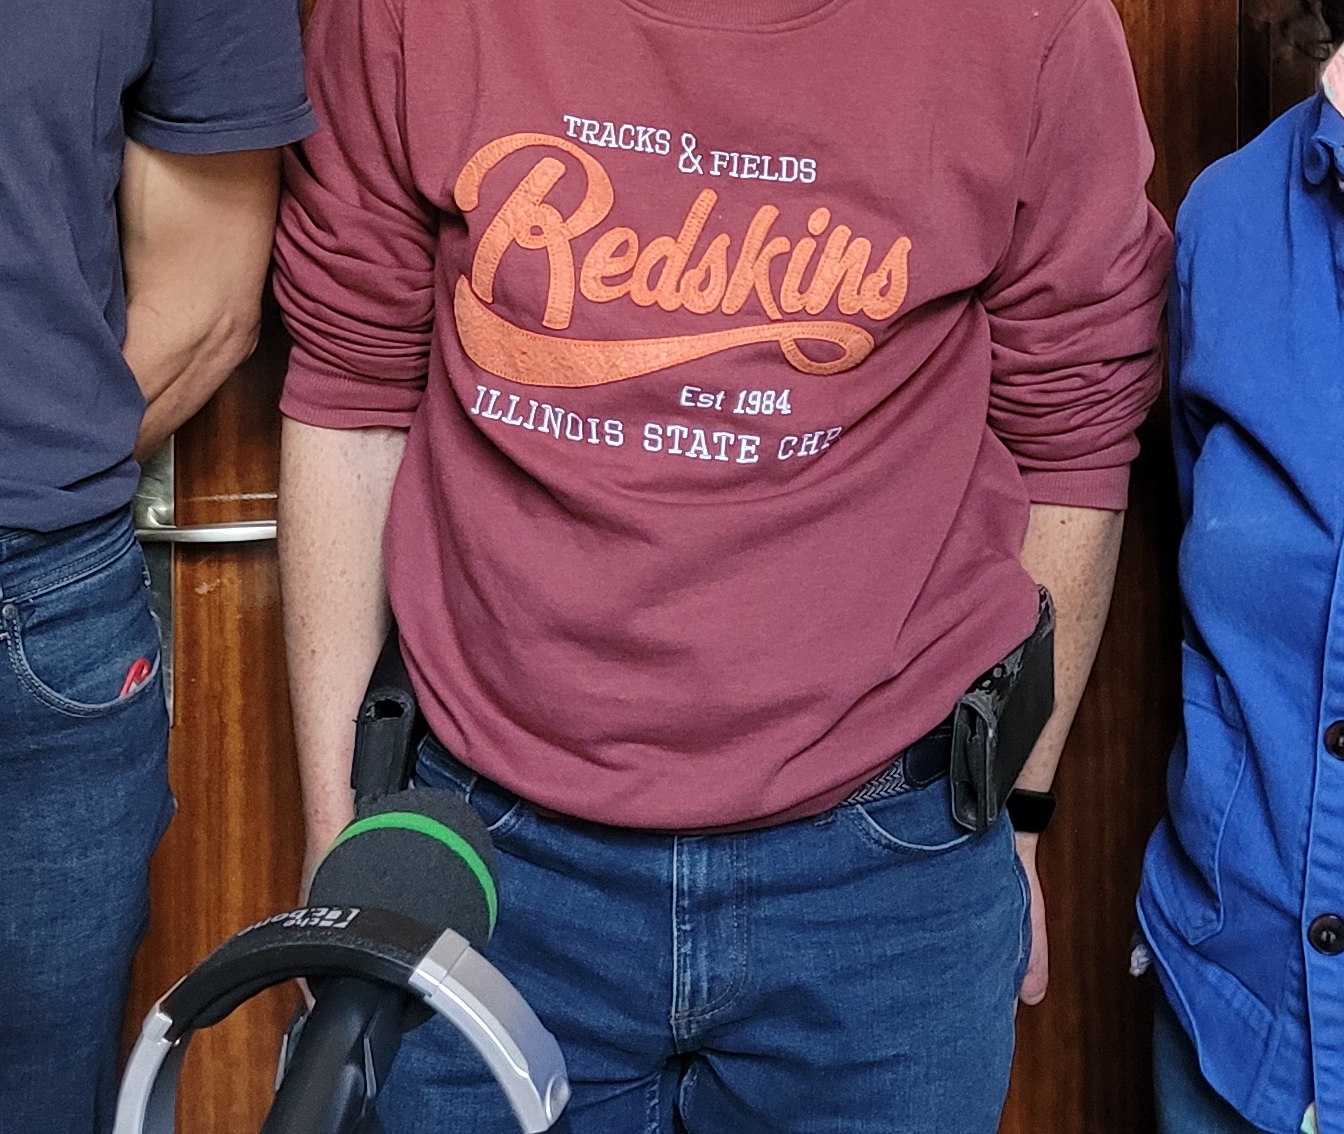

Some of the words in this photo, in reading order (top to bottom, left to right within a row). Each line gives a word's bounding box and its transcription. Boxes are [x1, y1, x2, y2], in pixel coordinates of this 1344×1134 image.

[563, 114, 671, 156] TRACKS
[678, 132, 704, 175] &
[709, 149, 817, 184] FIELDS
[454, 132, 912, 330] Redskins
[469, 385, 625, 447] ILLINOIS
[642, 423, 760, 465] STATE
[679, 385, 726, 413] Est
[734, 388, 793, 416] 1984
[236, 907, 330, 937] t.bon
